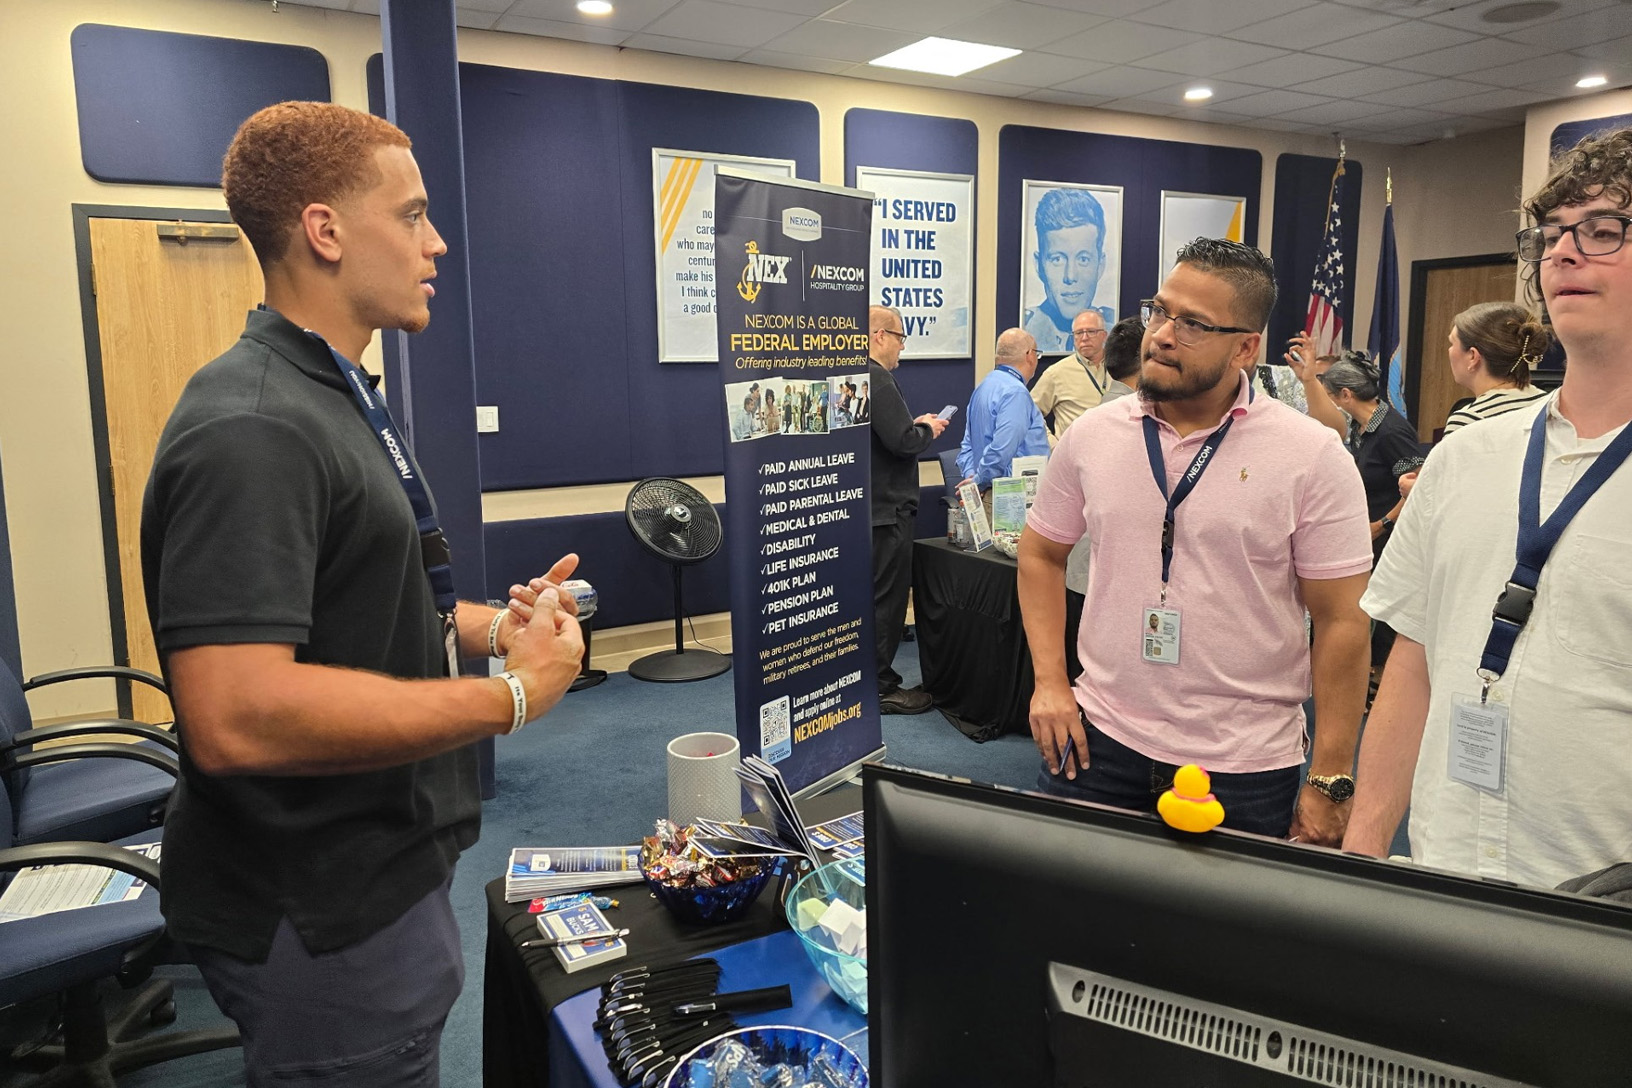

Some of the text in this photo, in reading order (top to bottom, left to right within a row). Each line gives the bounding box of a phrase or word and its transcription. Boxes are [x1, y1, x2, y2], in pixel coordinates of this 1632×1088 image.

[702, 210, 713, 219] no
[789, 216, 819, 228] NEXCOM
[892, 199, 957, 223] SERVED
[696, 225, 715, 235] care
[881, 228, 936, 250] IN THE
[676, 238, 715, 253] who may
[688, 256, 716, 267] centur
[746, 253, 790, 284] NEX
[881, 258, 943, 279] UNITED
[675, 270, 714, 282] make his
[810, 281, 865, 292] HOSPITALITY GROUP
[681, 285, 685, 297] I
[687, 286, 709, 298] think
[881, 287, 944, 308] STATES
[683, 304, 689, 313] a
[691, 302, 711, 315] good
[745, 314, 859, 330] NEXCOM IS A GLOBAL
[904, 316, 936, 336] VY.”
[730, 333, 869, 352] FEDERAL EMPLOYER
[735, 354, 868, 370] Offering industry leading benefits!
[765, 452, 855, 476] PAID ANNUAL LEAVE
[765, 473, 838, 496] PAID SICK LEAVE
[765, 488, 863, 516] PAID PARENTAL LEAVE
[766, 509, 850, 535] MEDICAL & DENTAL
[766, 533, 816, 555] DISABILITY
[767, 547, 839, 575] LIFE INSURANCE
[767, 571, 816, 595] 401K PLAN
[768, 585, 834, 614] PENSION PLAN
[769, 602, 839, 634] PET INSURANCE
[759, 617, 862, 660] We are proud to serve the men and
[762, 658, 787, 672] women
[788, 651, 801, 663] who
[803, 643, 823, 657] defend
[824, 640, 834, 650] our
[763, 670, 787, 685] military
[812, 654, 824, 666] and
[824, 650, 837, 661] their
[793, 670, 862, 708] Learn more about NEXCOM
[793, 694, 841, 722] and apply online at
[794, 702, 862, 744] NEXCOMjobs.org
[566, 916, 584, 935] BUCKS
[578, 913, 600, 931] SAM
